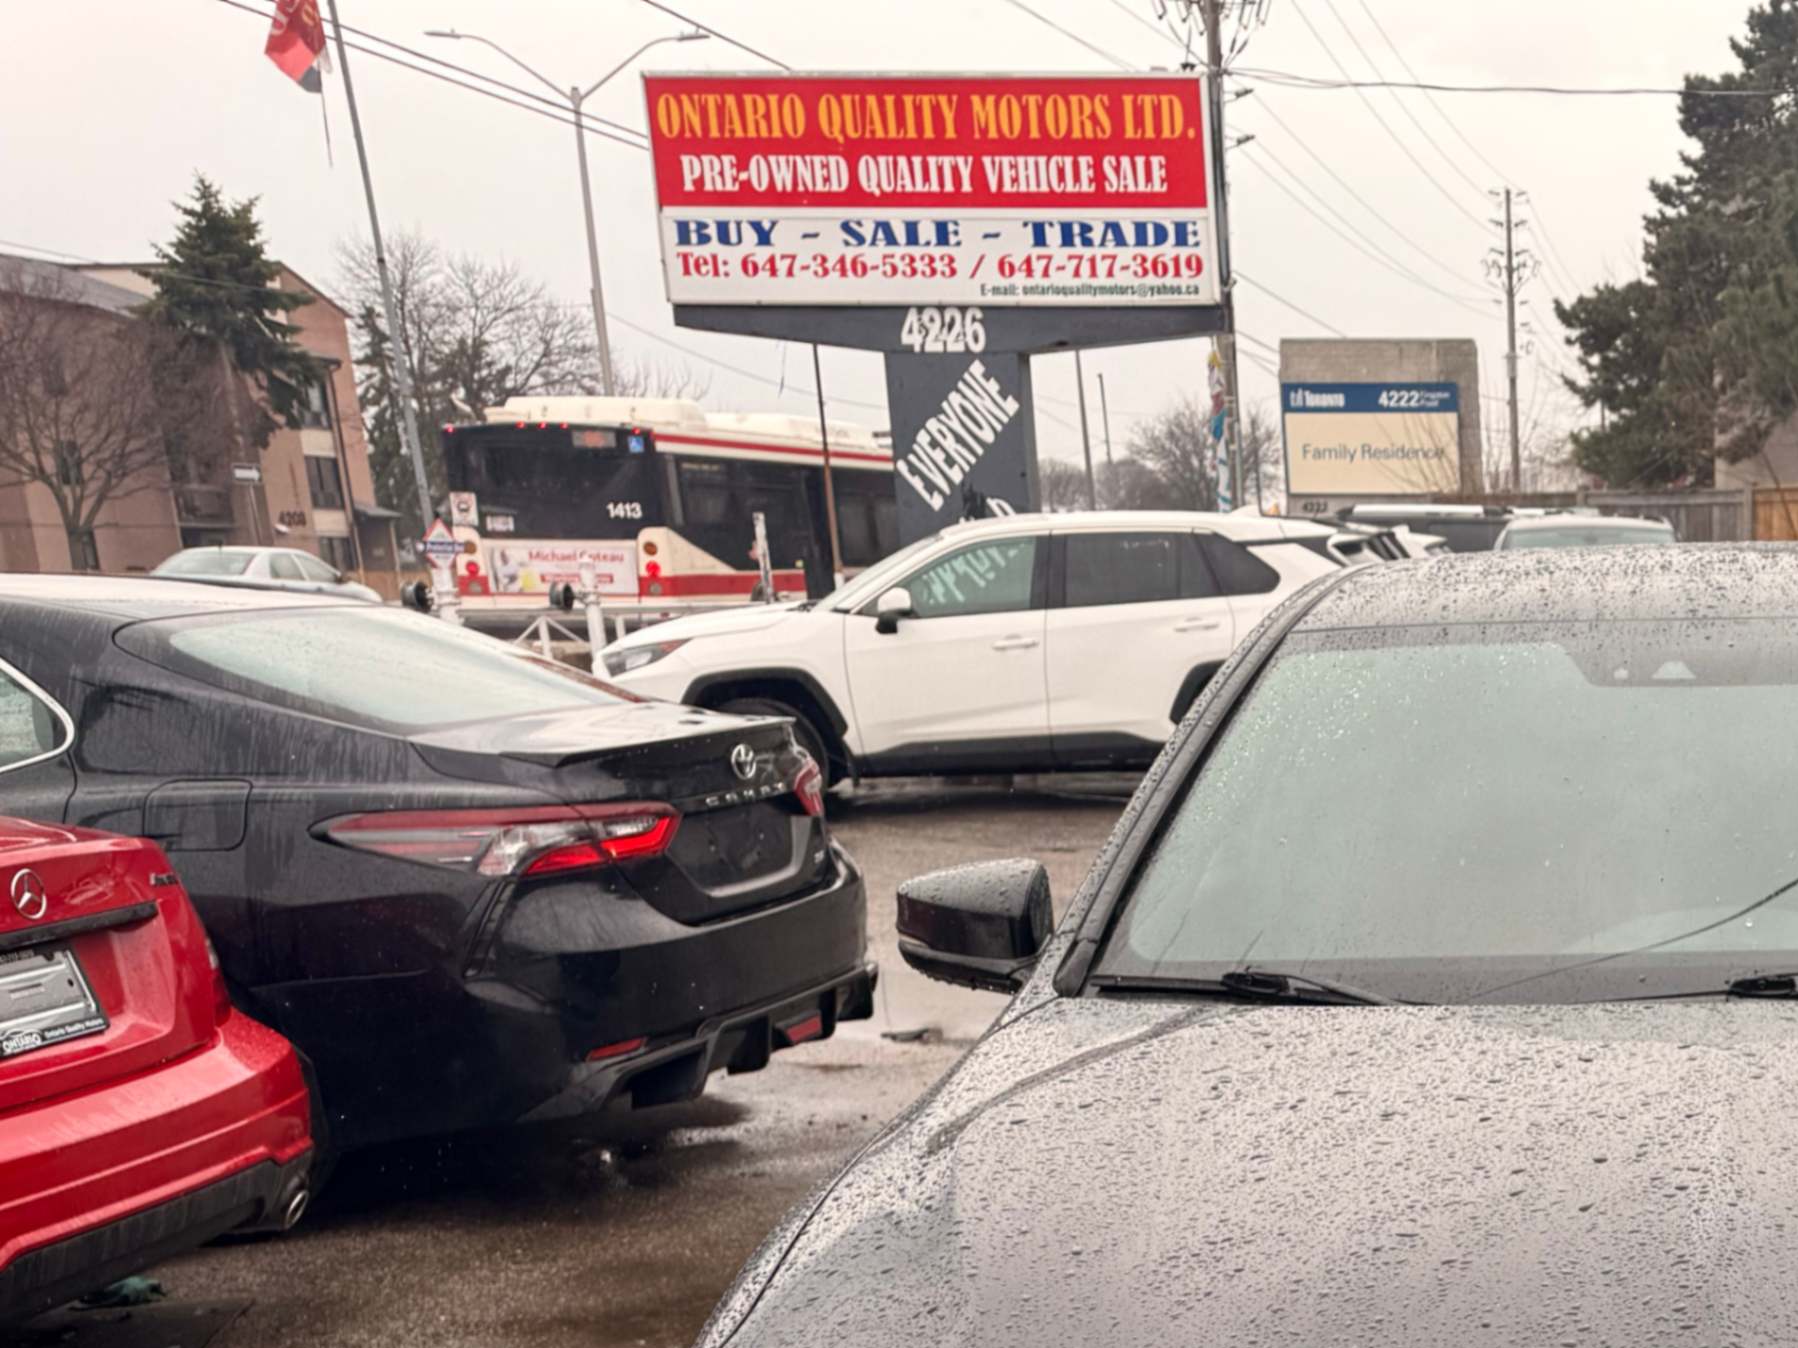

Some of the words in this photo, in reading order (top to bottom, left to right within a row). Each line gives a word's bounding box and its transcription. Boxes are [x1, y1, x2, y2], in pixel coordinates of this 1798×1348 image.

[657, 93, 805, 139] ONTARIO
[817, 93, 958, 144] QUALITY
[970, 93, 1112, 139] MOTORS
[1122, 93, 1195, 139] LTD.
[680, 154, 849, 192] PRE-OWNED
[858, 154, 972, 197] QUALITY
[981, 154, 1096, 193] VEHICLE
[1102, 154, 1167, 193] SALE
[674, 219, 779, 247] BUY
[839, 219, 962, 248] SALE
[1022, 219, 1200, 248] TRADE
[676, 252, 731, 278] Tel:
[740, 252, 957, 279] 647-346-5333
[998, 252, 1204, 279] 647-717-3619
[980, 283, 1019, 296] E-mail:
[1022, 283, 1200, 298] ontarioqualitymotors@yahoo.ca
[901, 306, 986, 353] 4226
[1378, 389, 1420, 408] 4222
[896, 359, 1020, 511] EVERYONE
[1302, 443, 1356, 464] Family
[1360, 443, 1445, 461] Residence
[606, 502, 643, 519] 1413
